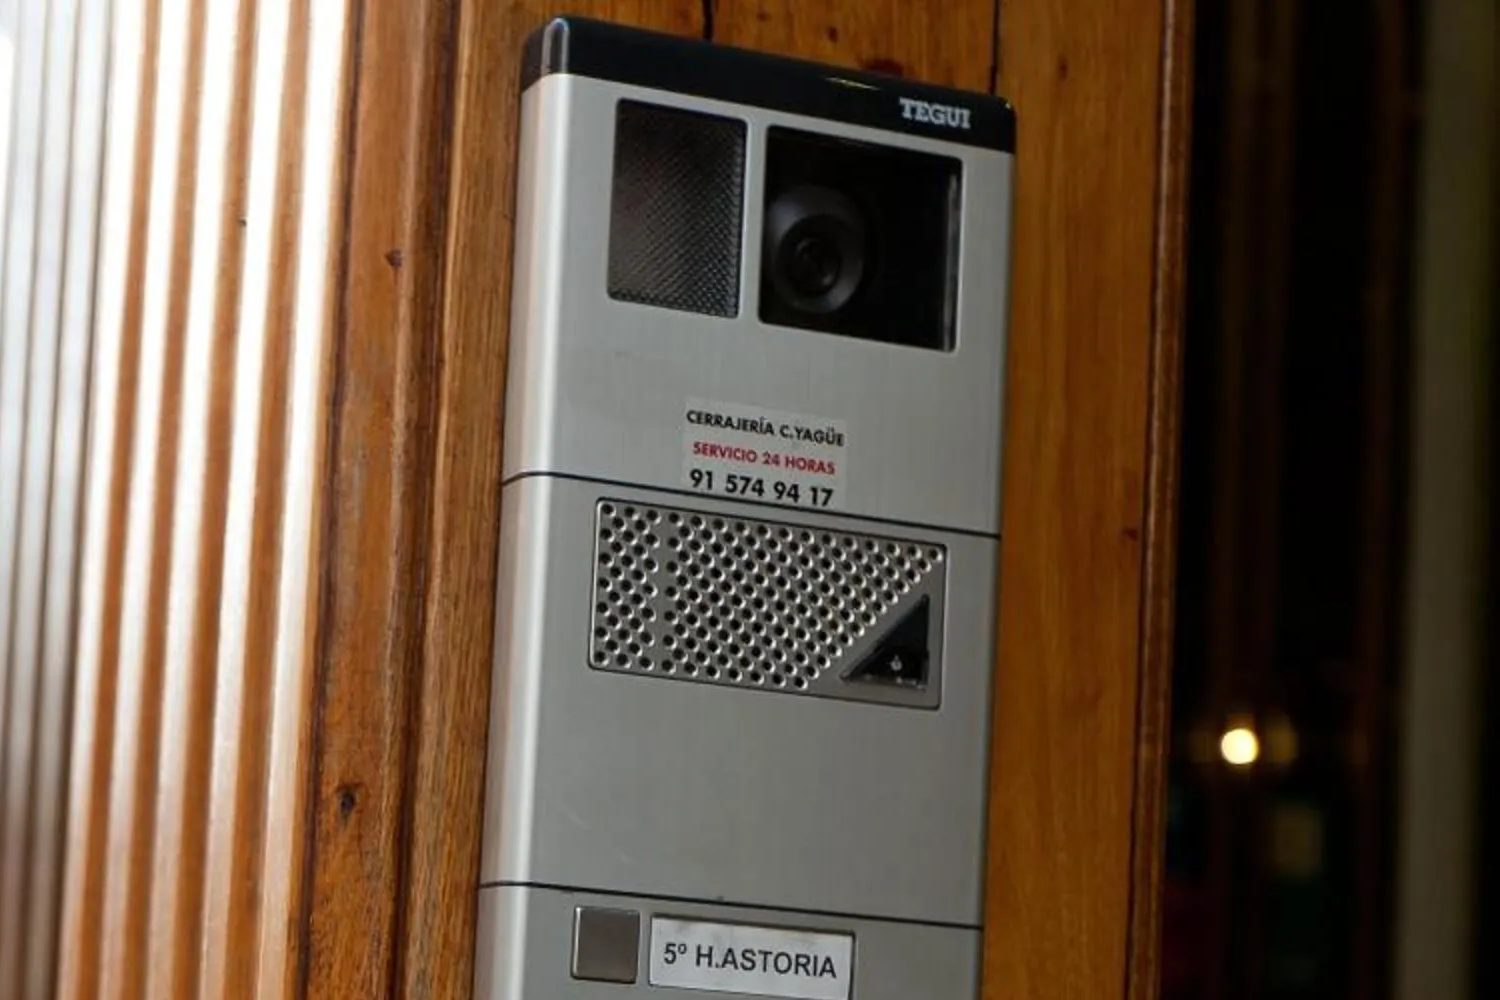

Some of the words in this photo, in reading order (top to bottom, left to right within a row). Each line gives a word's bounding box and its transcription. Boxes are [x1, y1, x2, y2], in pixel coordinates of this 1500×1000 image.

[898, 97, 972, 130] TEGUI
[686, 409, 775, 436] CERRAJERÍA
[779, 423, 845, 447] C.YAGÜE
[693, 441, 757, 463] SERVICIO
[762, 451, 781, 467] 24
[785, 456, 836, 476] HORAS
[690, 468, 714, 490] 91
[725, 473, 765, 497] 574
[773, 481, 801, 504] 94
[809, 486, 835, 507] 17
[695, 944, 838, 979] H.ASTORIA
